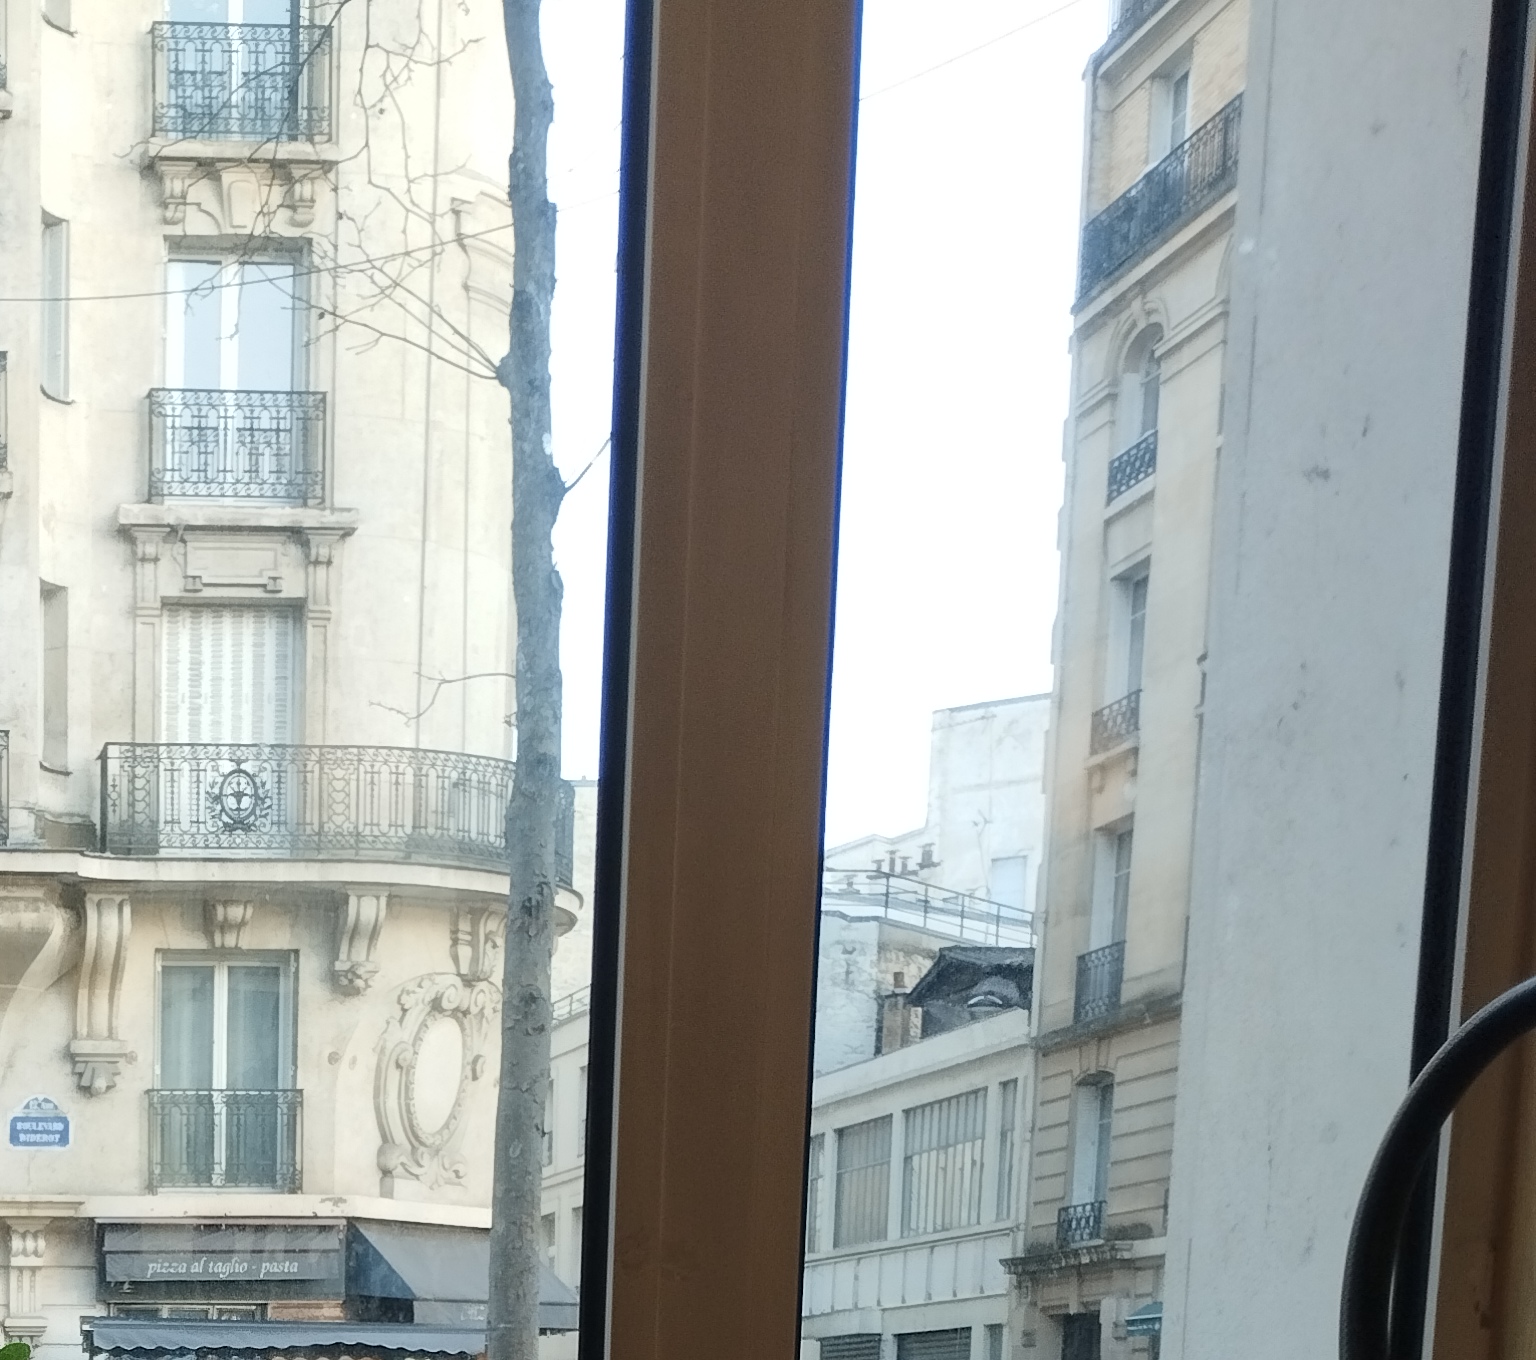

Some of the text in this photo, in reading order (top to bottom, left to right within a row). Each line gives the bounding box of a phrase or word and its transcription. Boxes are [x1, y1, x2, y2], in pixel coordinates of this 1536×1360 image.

[16, 1121, 65, 1131] BOULEVARD
[18, 1133, 61, 1143] DIDEROT
[146, 1259, 187, 1279] pizza
[190, 1256, 207, 1273] al
[208, 1256, 248, 1279] taglio
[259, 1260, 299, 1279] pasta
